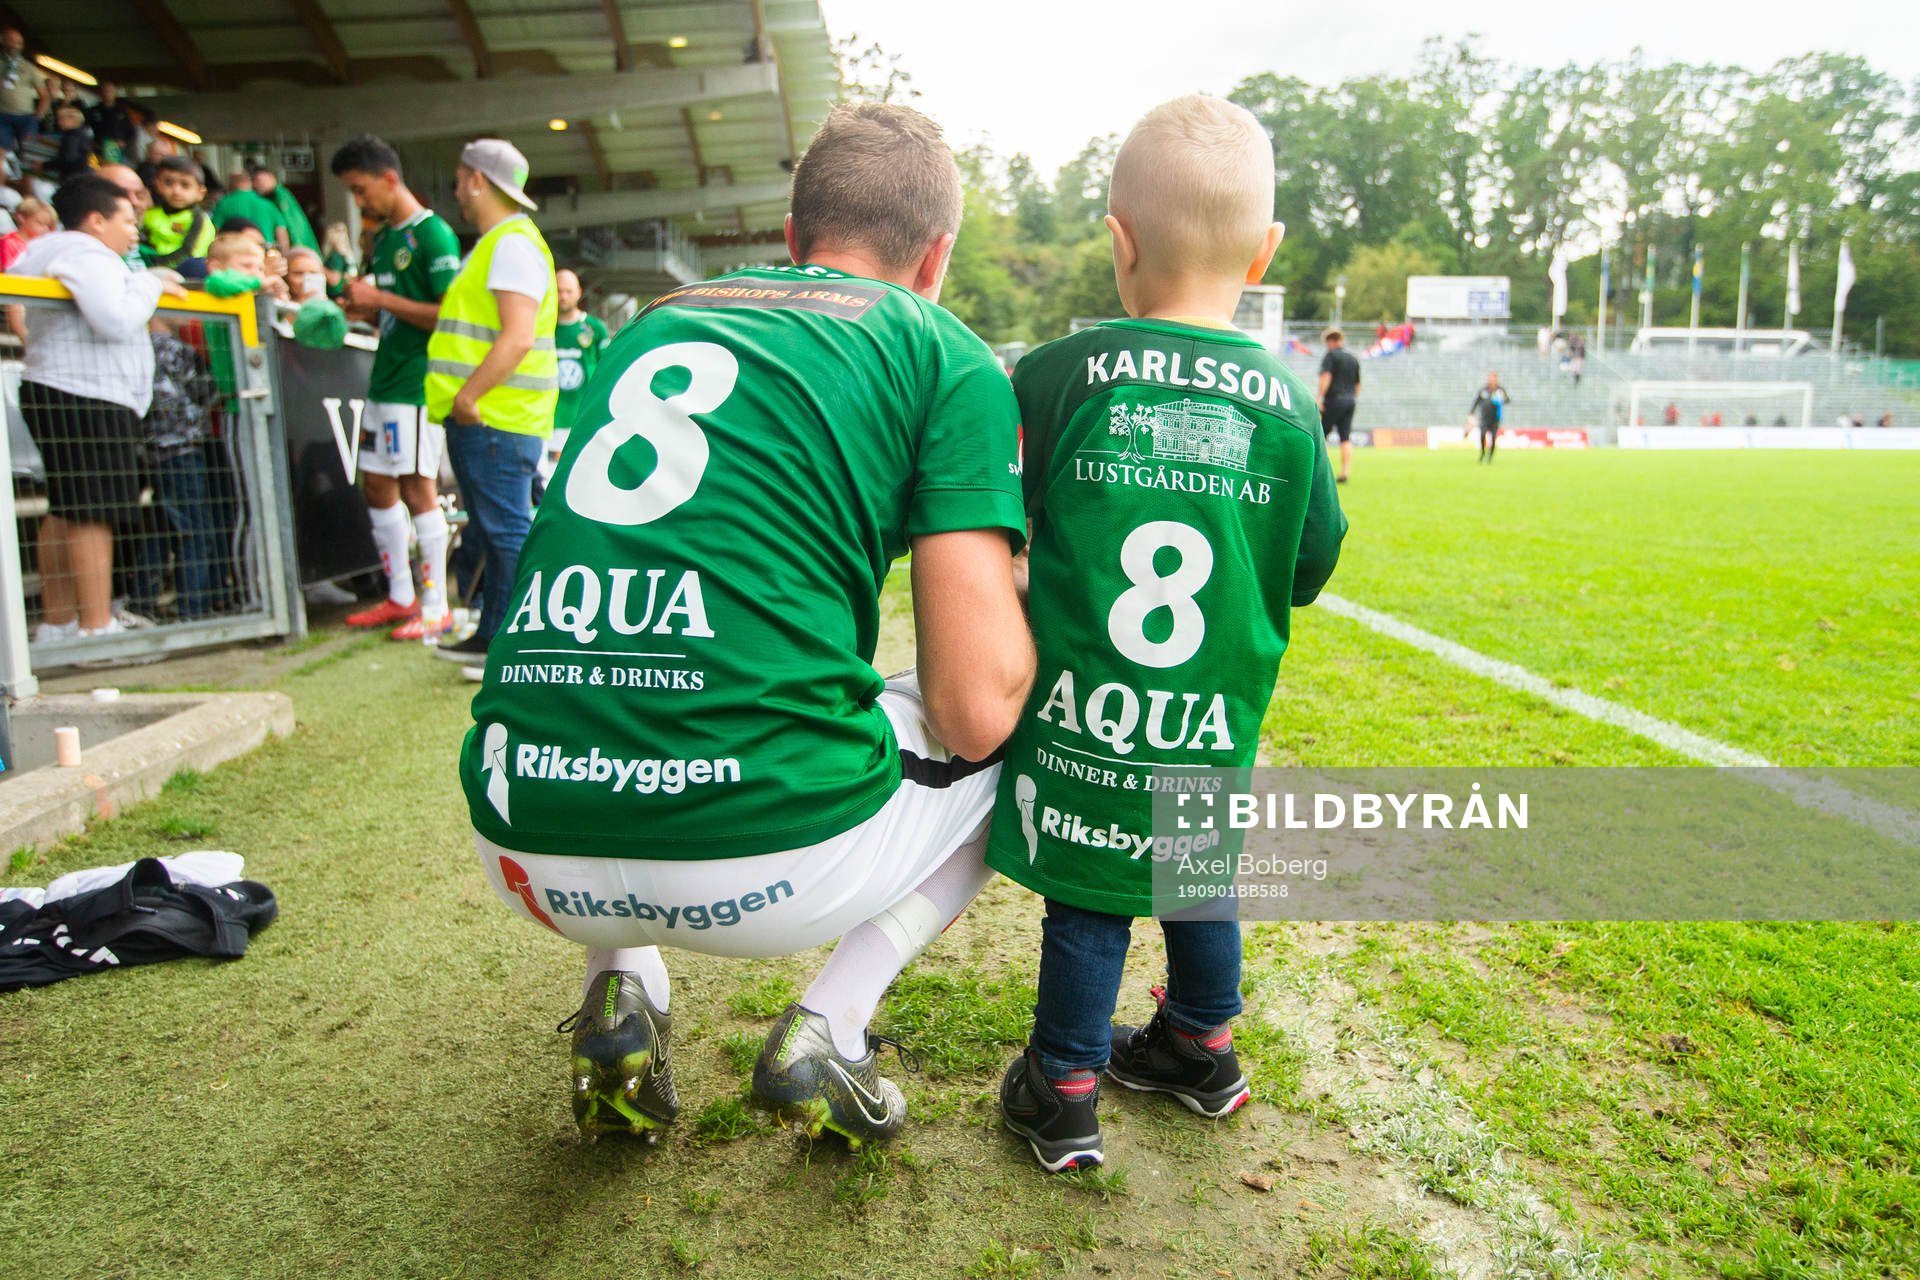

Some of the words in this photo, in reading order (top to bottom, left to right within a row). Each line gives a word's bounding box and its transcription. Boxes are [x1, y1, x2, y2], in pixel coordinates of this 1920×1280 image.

[686, 287, 790, 300] BISHOPS
[791, 290, 868, 308] ARMS
[1087, 349, 1293, 411] KARLSSON
[565, 342, 740, 526] 8
[1074, 458, 1235, 498] LUSTGÅRDEN
[1238, 479, 1272, 505] AB
[506, 564, 715, 644] AQUA
[1107, 520, 1214, 669] 8
[500, 664, 584, 686] DINNER
[588, 666, 605, 686] &
[610, 667, 705, 691] DRINKS
[1036, 669, 1236, 755] AQUA
[516, 743, 742, 795] Riksbyggen
[1036, 746, 1118, 788] DINNER
[1122, 773, 1139, 791] &
[1143, 774, 1223, 793] DRINKS
[1040, 805, 1221, 863] Riksbyggen
[544, 879, 796, 931] Riksbyggen
